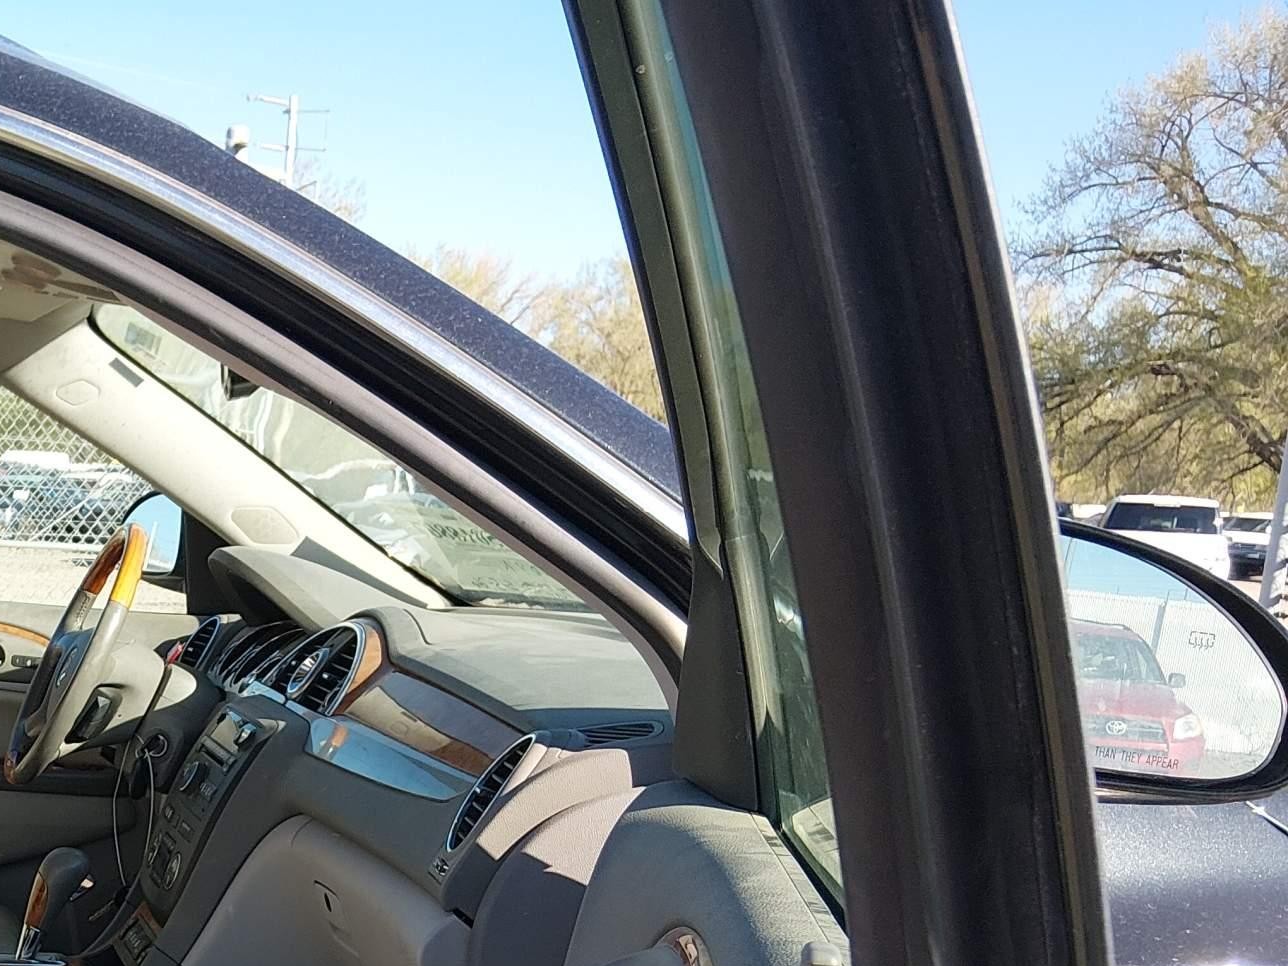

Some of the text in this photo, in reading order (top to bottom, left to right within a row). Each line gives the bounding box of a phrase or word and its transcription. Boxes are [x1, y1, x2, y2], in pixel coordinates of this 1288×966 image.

[1095, 745, 1179, 769] THAN THEY APPEAR
